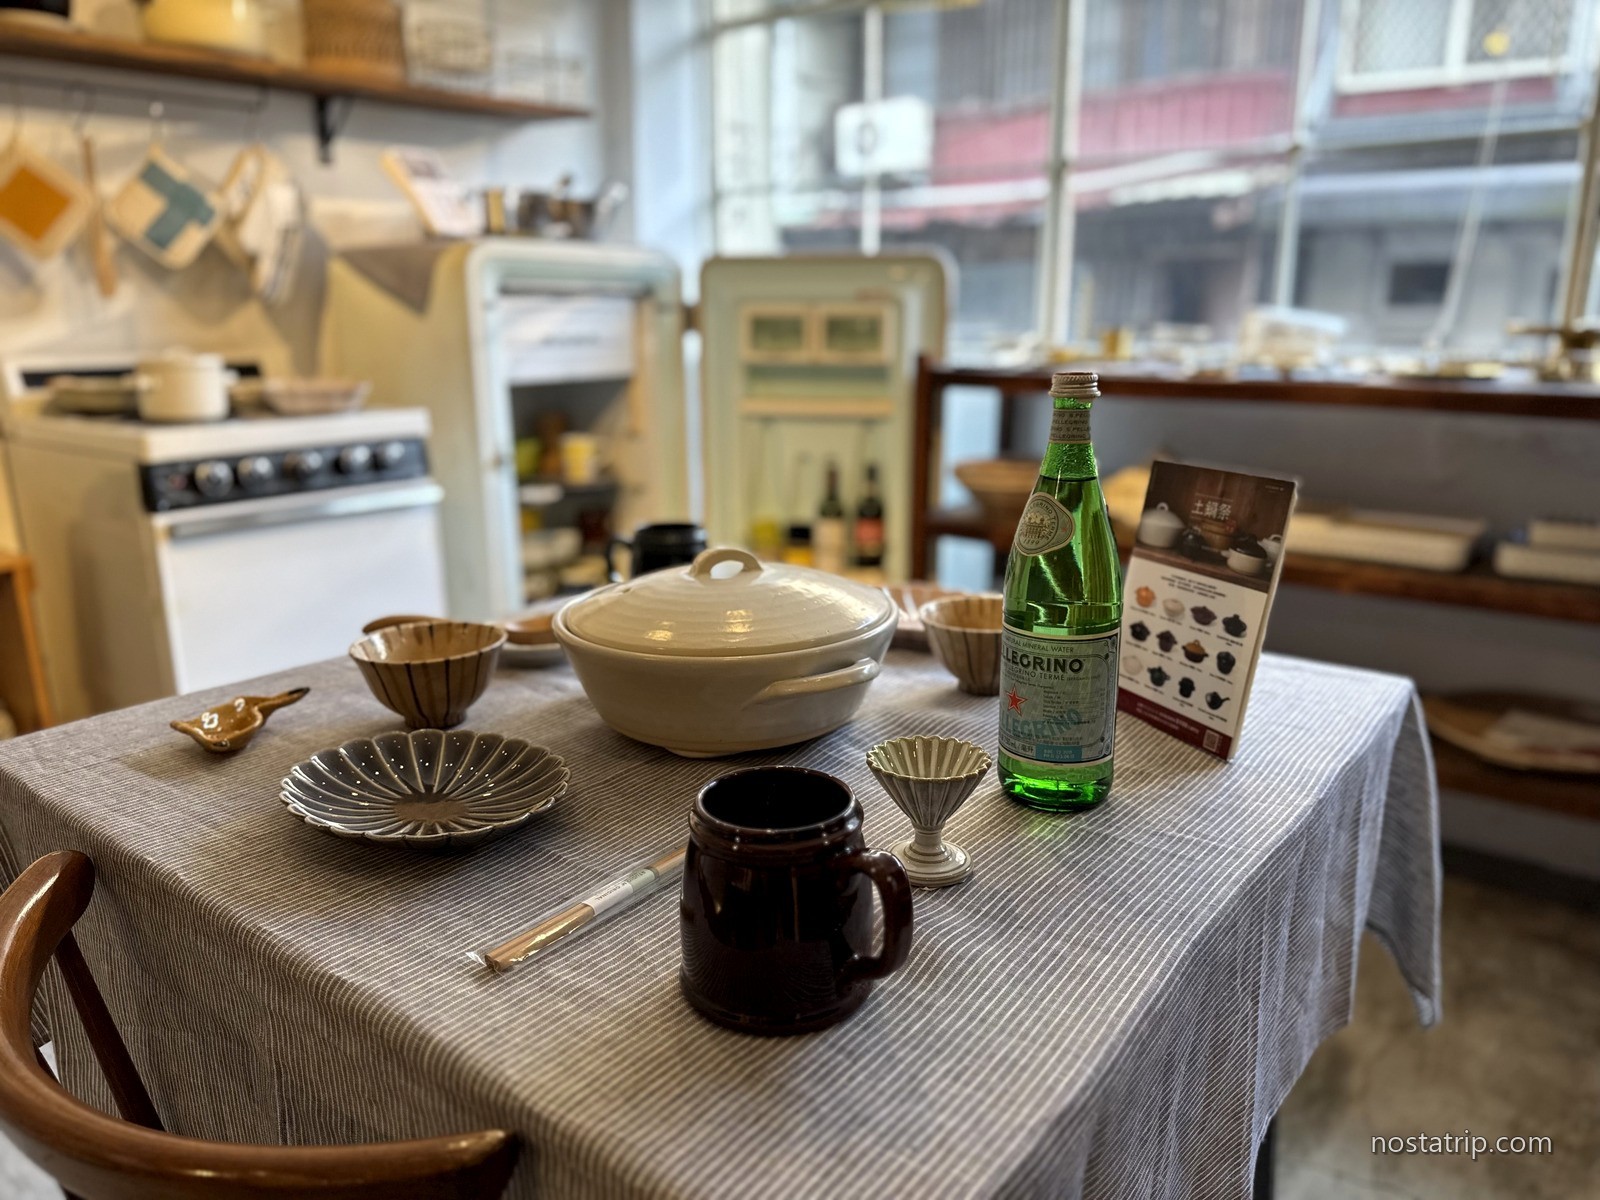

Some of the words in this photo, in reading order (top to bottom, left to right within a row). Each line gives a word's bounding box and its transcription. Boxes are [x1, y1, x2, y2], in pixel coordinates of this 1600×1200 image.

[1191, 499, 1232, 521] 土鍋祭
[1022, 641, 1048, 652] MINERAL
[1051, 645, 1074, 653] WATER
[595, 885, 621, 901] ORIGINAL
